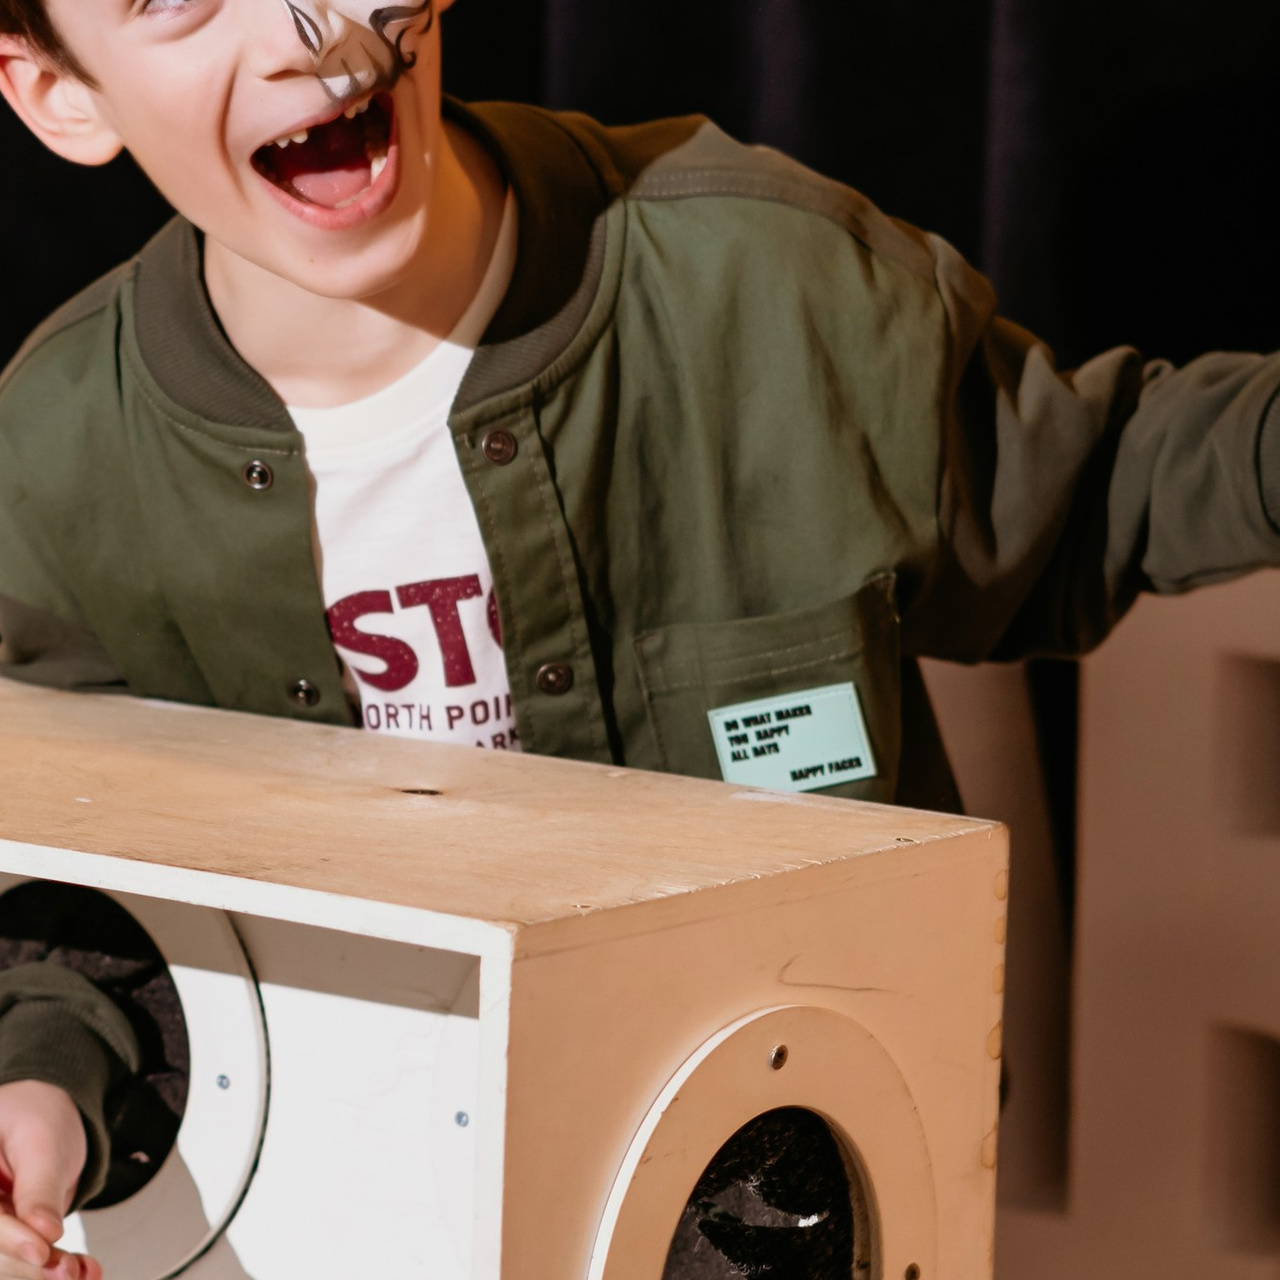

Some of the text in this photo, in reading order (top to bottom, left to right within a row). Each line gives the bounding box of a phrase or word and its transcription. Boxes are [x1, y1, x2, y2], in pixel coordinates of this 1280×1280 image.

[327, 574, 503, 693] ST
[361, 703, 432, 731] ORTH
[724, 704, 812, 732] DO WHAT MAKES
[476, 727, 520, 749] RK
[728, 724, 789, 747] YOU HAPPY
[731, 742, 780, 763] ALL DAYS
[790, 756, 862, 782] HAPPY FACES
